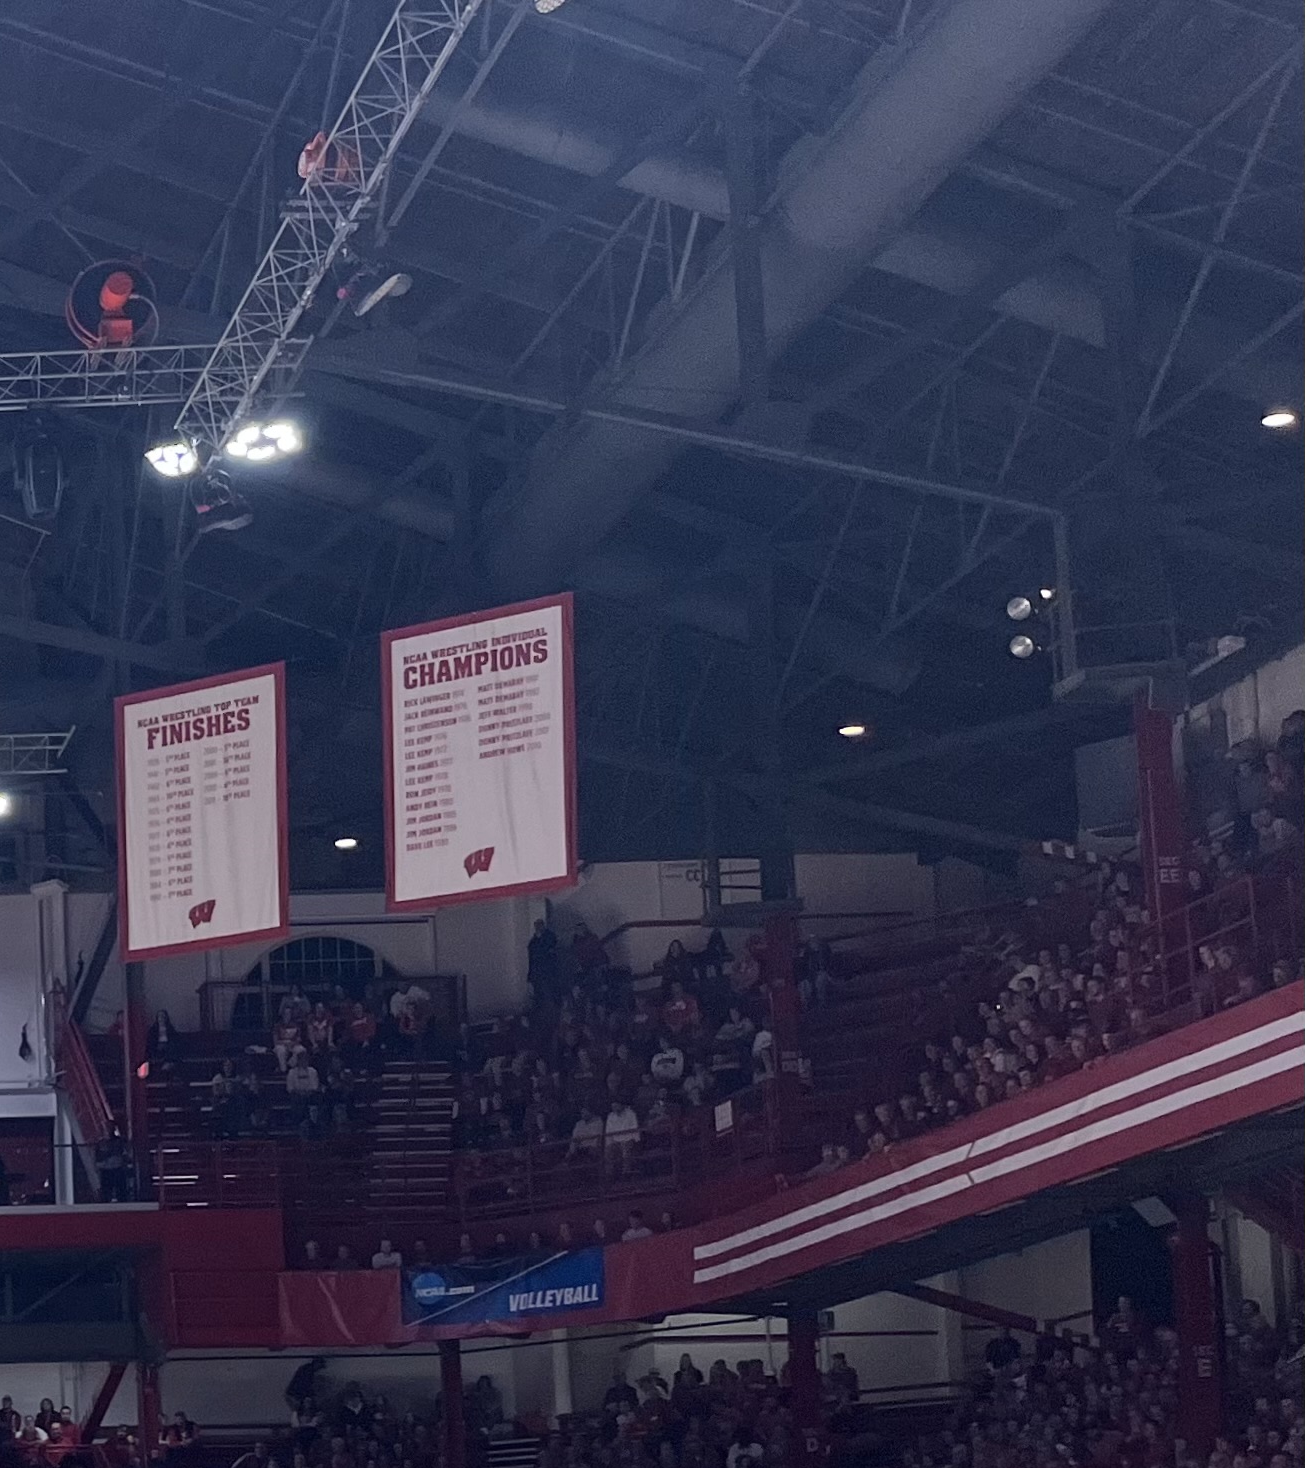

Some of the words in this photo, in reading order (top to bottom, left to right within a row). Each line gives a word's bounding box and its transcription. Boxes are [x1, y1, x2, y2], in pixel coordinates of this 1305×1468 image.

[403, 654, 428, 666] NCAA
[432, 639, 488, 660] WRESTLING
[491, 627, 548, 647] INDIVIDUAL
[403, 639, 548, 690] CHAMPIONS
[147, 708, 251, 750] FINISHES
[162, 703, 211, 726] WRESTLING
[214, 699, 232, 711] TOP
[234, 694, 260, 707] TEAM
[509, 1284, 599, 1312] VOLLEYBALL
